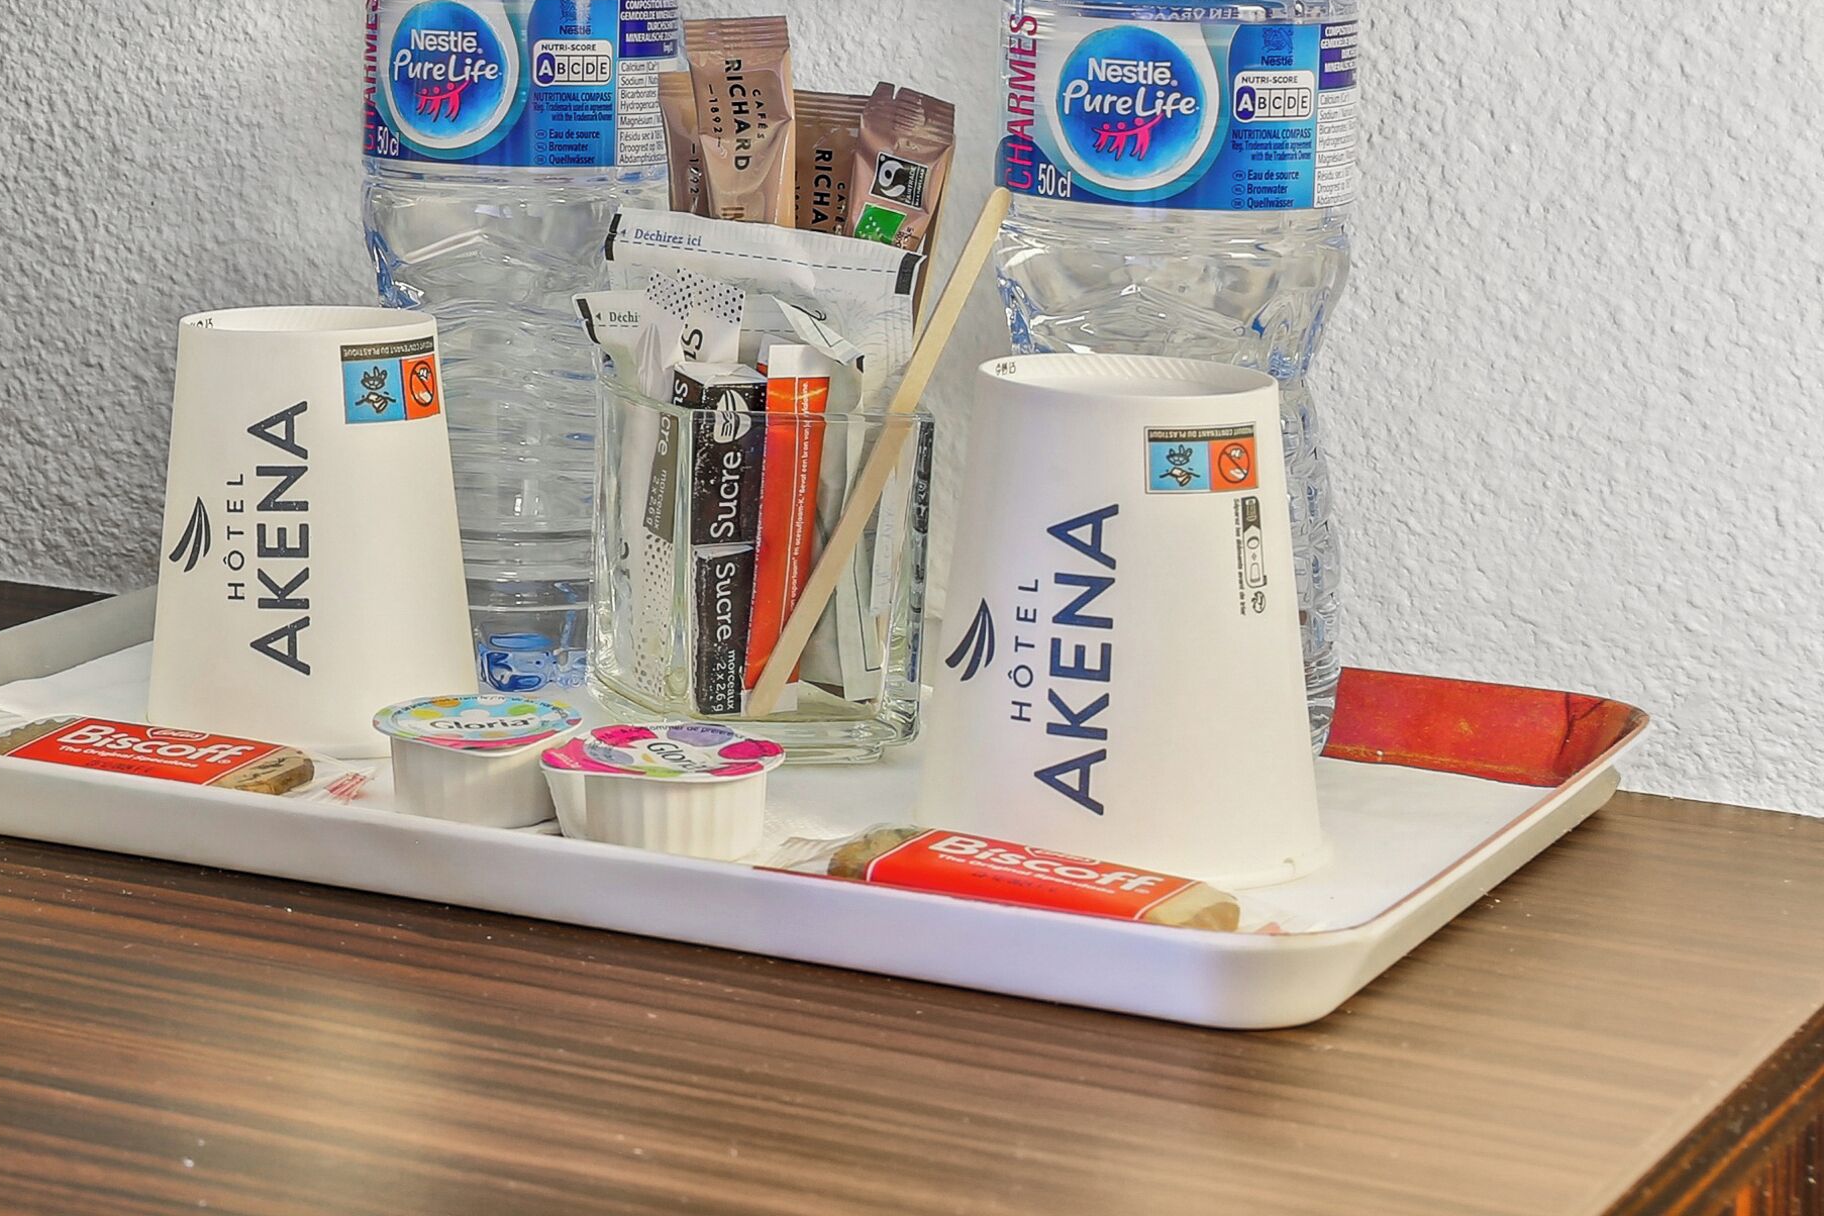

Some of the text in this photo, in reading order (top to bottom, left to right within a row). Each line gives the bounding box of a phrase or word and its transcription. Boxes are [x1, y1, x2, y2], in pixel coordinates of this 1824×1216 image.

[539, 60, 608, 77] A B C D E
[1241, 76, 1298, 84] NUTRI-SCORE
[533, 92, 612, 102] NUTRITIONAL COMPASS
[1004, 13, 1038, 190] CHARMES
[1237, 93, 1308, 112] A B C D E
[724, 59, 752, 171] RICHARD
[377, 126, 399, 156] 50 cl
[549, 129, 600, 139] Eau de source
[1231, 128, 1312, 139] NUTRITIONAL COMPASS
[1037, 163, 1071, 198] 50 cl
[1248, 170, 1263, 181] Eau
[1264, 170, 1275, 181] de
[1275, 171, 1299, 180] source
[810, 149, 833, 233] RICHA
[635, 228, 701, 246] Déchirez ici
[609, 311, 639, 323] Déchi
[654, 469, 668, 530] morceaux
[710, 451, 742, 538] Sucre
[223, 473, 245, 600] HÔTEL
[247, 400, 311, 676] AKENA
[715, 562, 735, 642] Sucre
[1007, 578, 1039, 722] HÔTEL
[1034, 503, 1119, 816] AKENA
[716, 663, 726, 671] 2
[727, 649, 735, 710] morceaux
[715, 683, 726, 701] 2,6
[712, 704, 724, 712] g
[429, 717, 529, 731] Gloria
[57, 724, 255, 764] Biscoff
[59, 745, 83, 754] The
[83, 747, 134, 760] Original
[647, 742, 708, 773] Glori
[928, 835, 1165, 891] Biscoff
[937, 853, 966, 864] The
[969, 858, 1032, 876] Original
